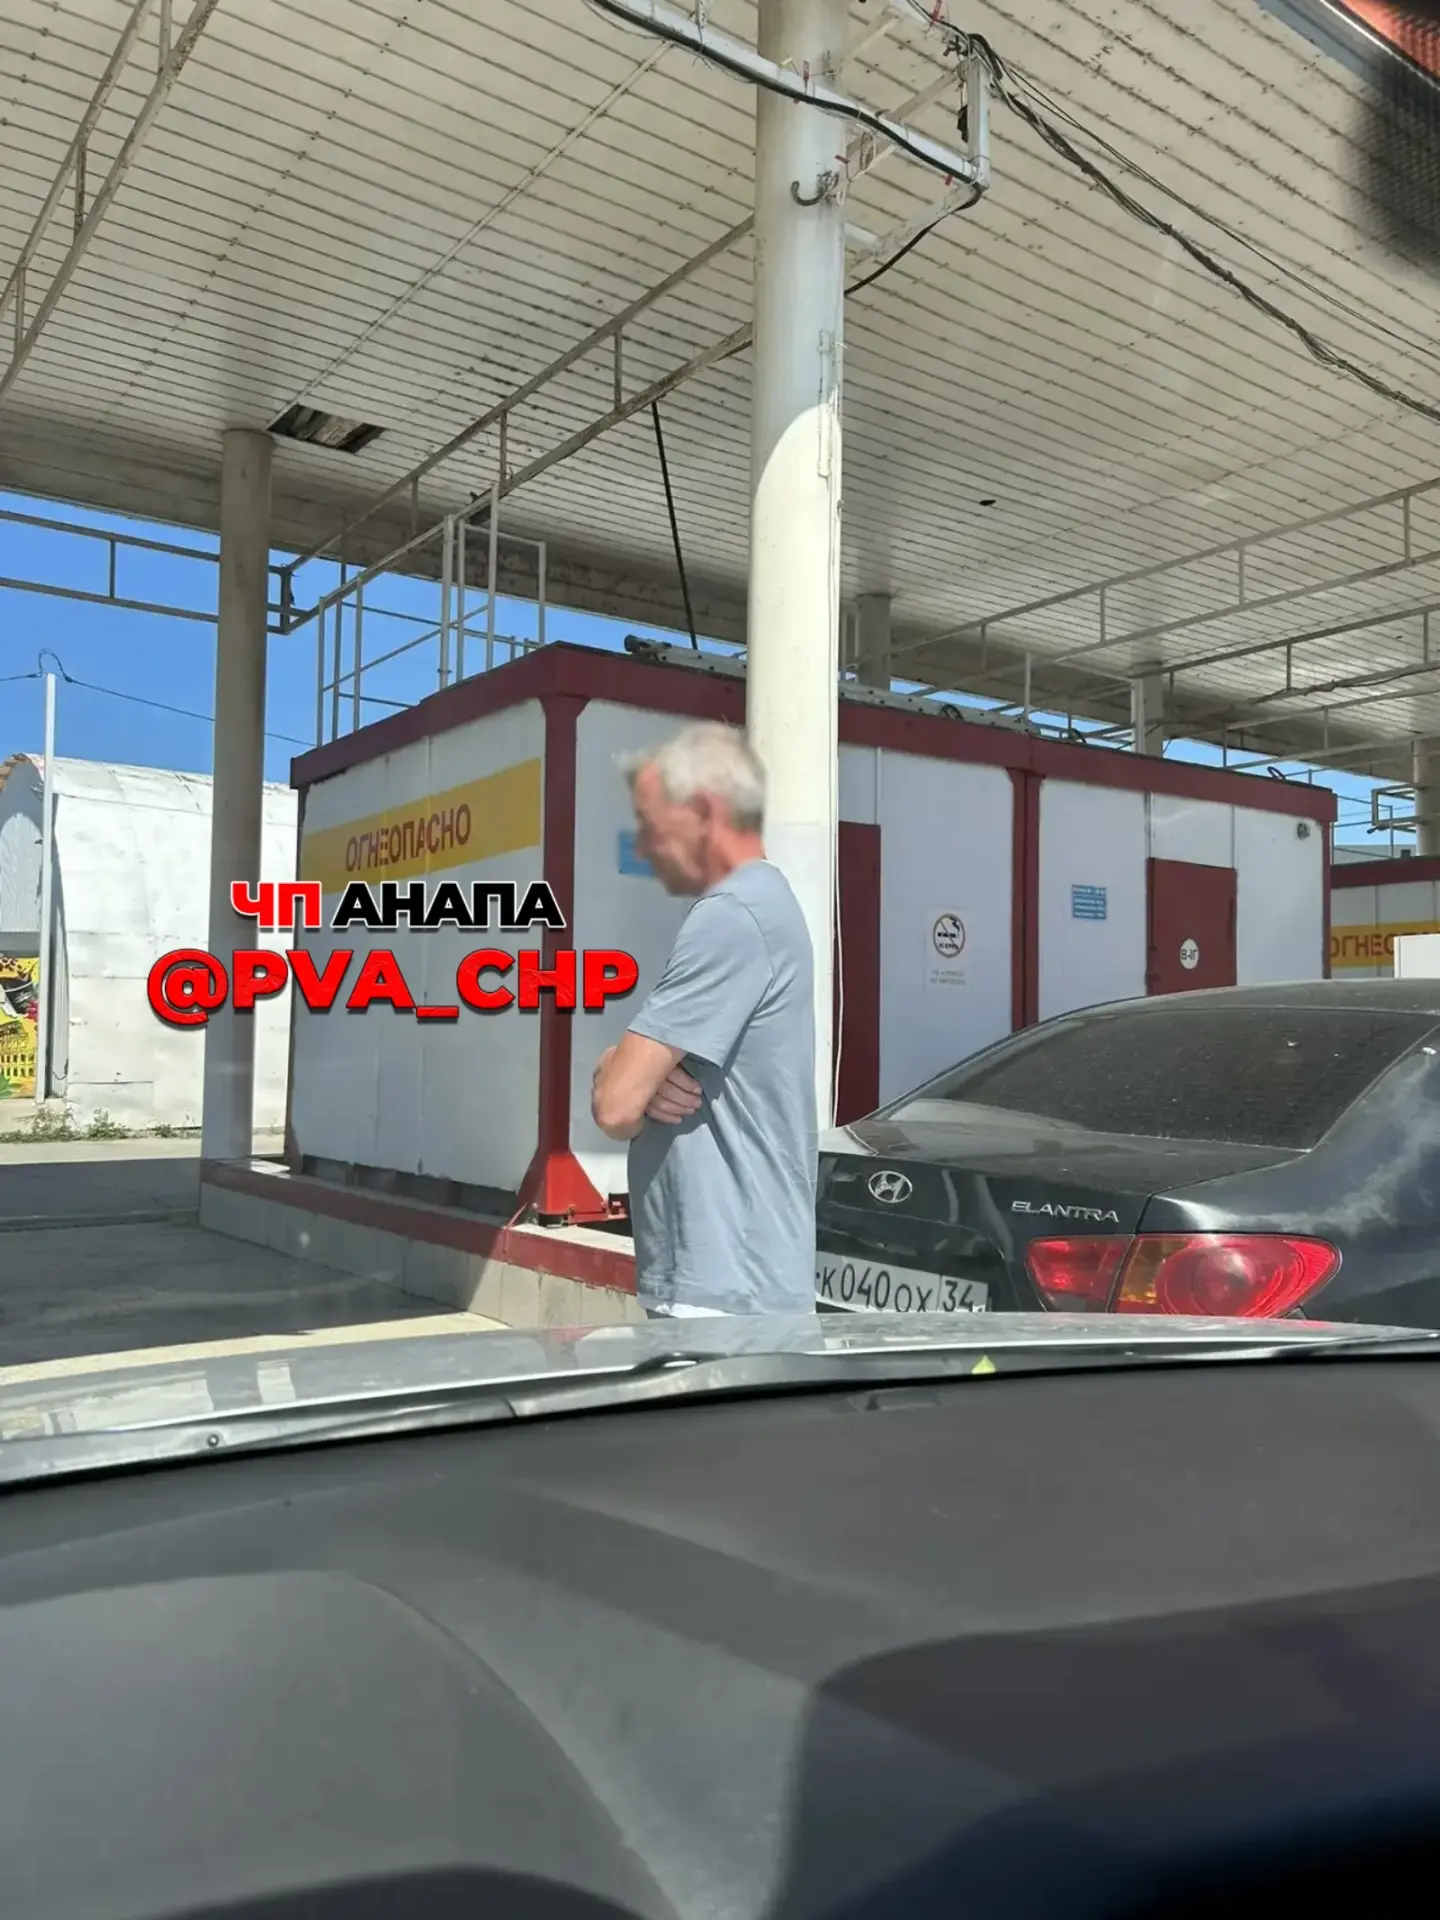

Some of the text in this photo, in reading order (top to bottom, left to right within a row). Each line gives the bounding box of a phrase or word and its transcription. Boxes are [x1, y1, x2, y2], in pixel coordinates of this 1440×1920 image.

[346, 803, 471, 872] ОГНЕОПАСНО
[1011, 1200, 1119, 1223] ELANTRA
[942, 1280, 975, 1313] 34
